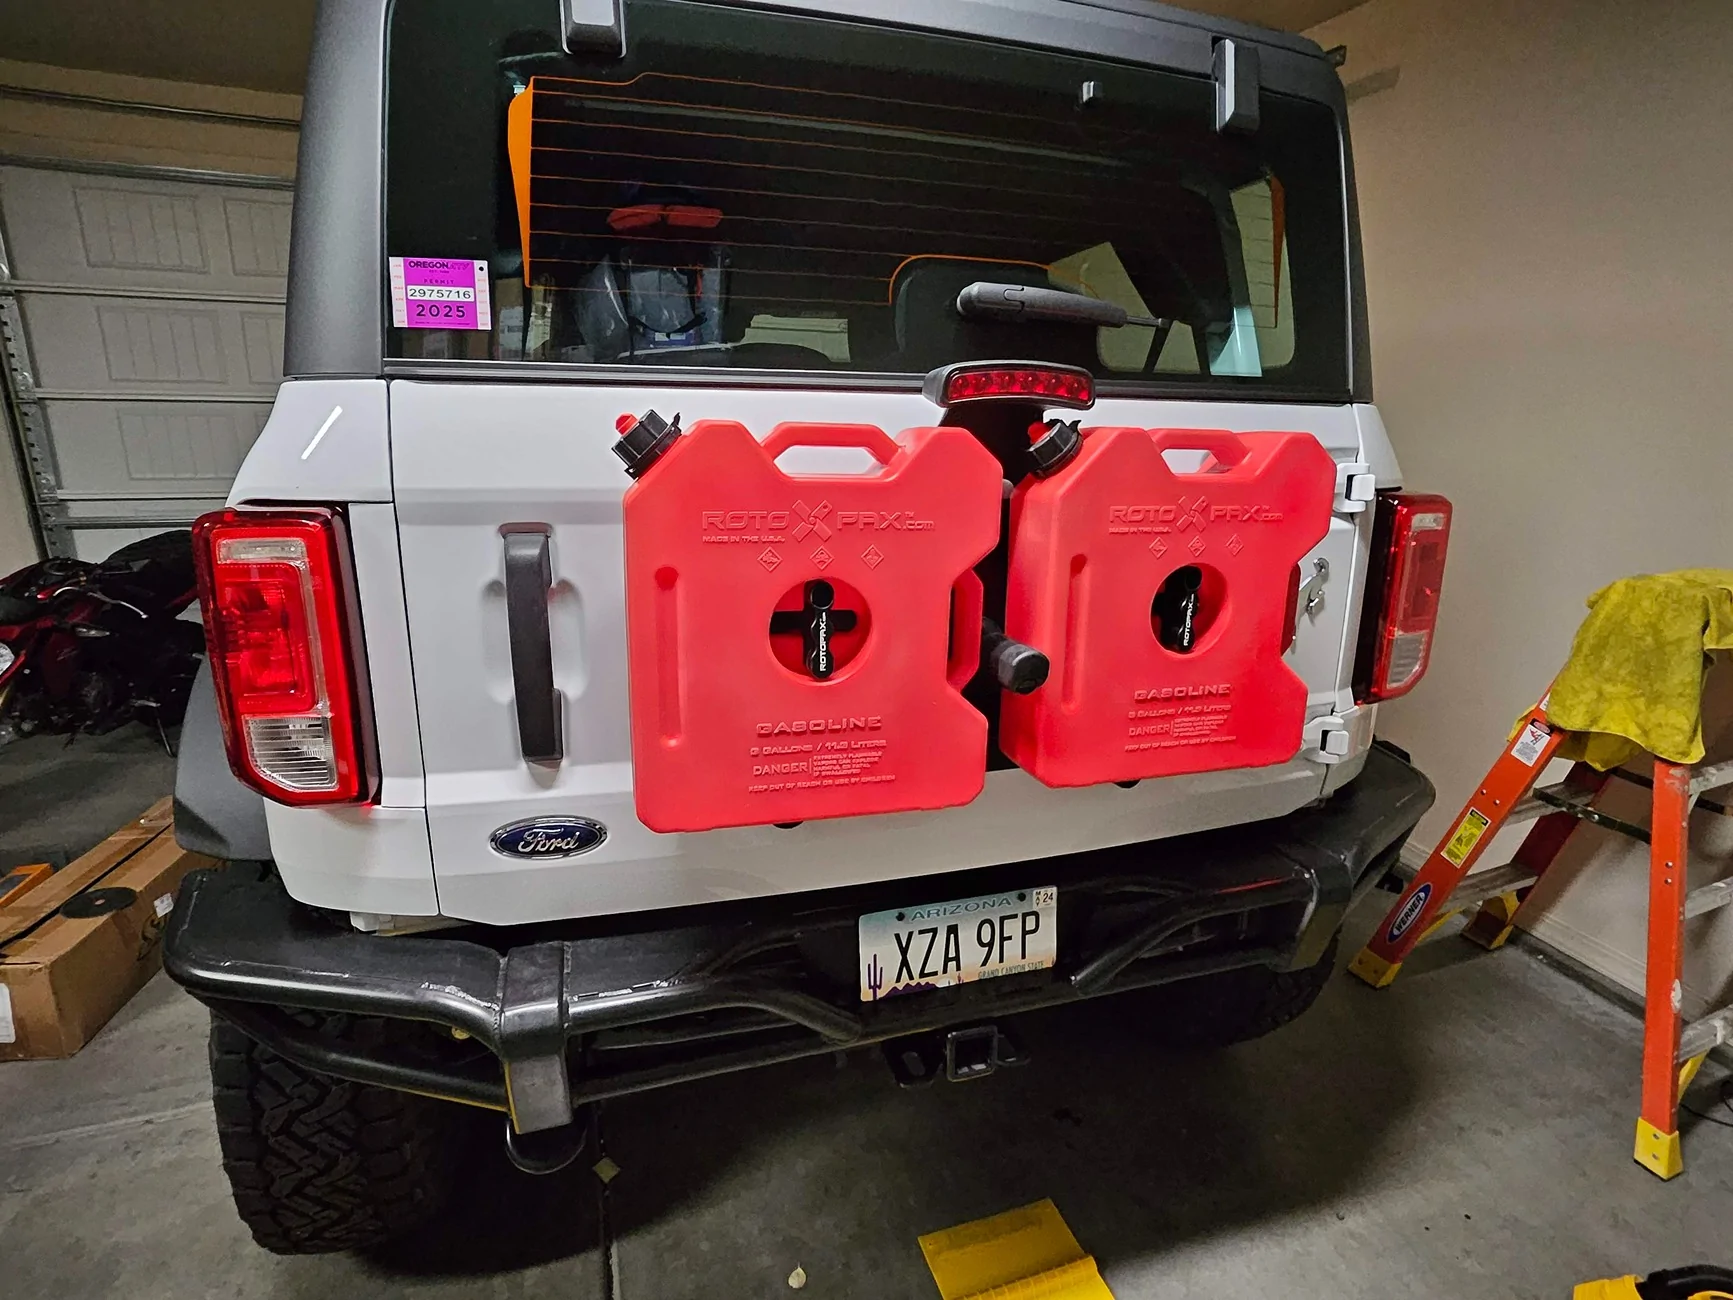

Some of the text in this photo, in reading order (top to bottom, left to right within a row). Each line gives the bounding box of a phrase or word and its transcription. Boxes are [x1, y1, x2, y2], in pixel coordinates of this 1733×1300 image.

[408, 260, 449, 269] OREGON
[409, 288, 471, 299] 2975716
[416, 304, 466, 318] 2025
[702, 510, 790, 531] ROTO
[1109, 504, 1177, 523] ROTO
[1183, 602, 1194, 647] ROTOPAX
[819, 621, 827, 672] ROTOPAX
[1134, 683, 1231, 703] GASOLINE
[756, 715, 882, 737] GASOLINE
[1129, 723, 1170, 737] DANGER
[753, 761, 808, 777] DANGER
[518, 828, 580, 853] Ford
[1042, 892, 1054, 903] 24
[910, 897, 1013, 922] ARIZONA
[1395, 894, 1424, 933] WERNER
[893, 910, 1041, 984] XZA 9FP
[977, 960, 1045, 979] GRAND CANYON STATE
